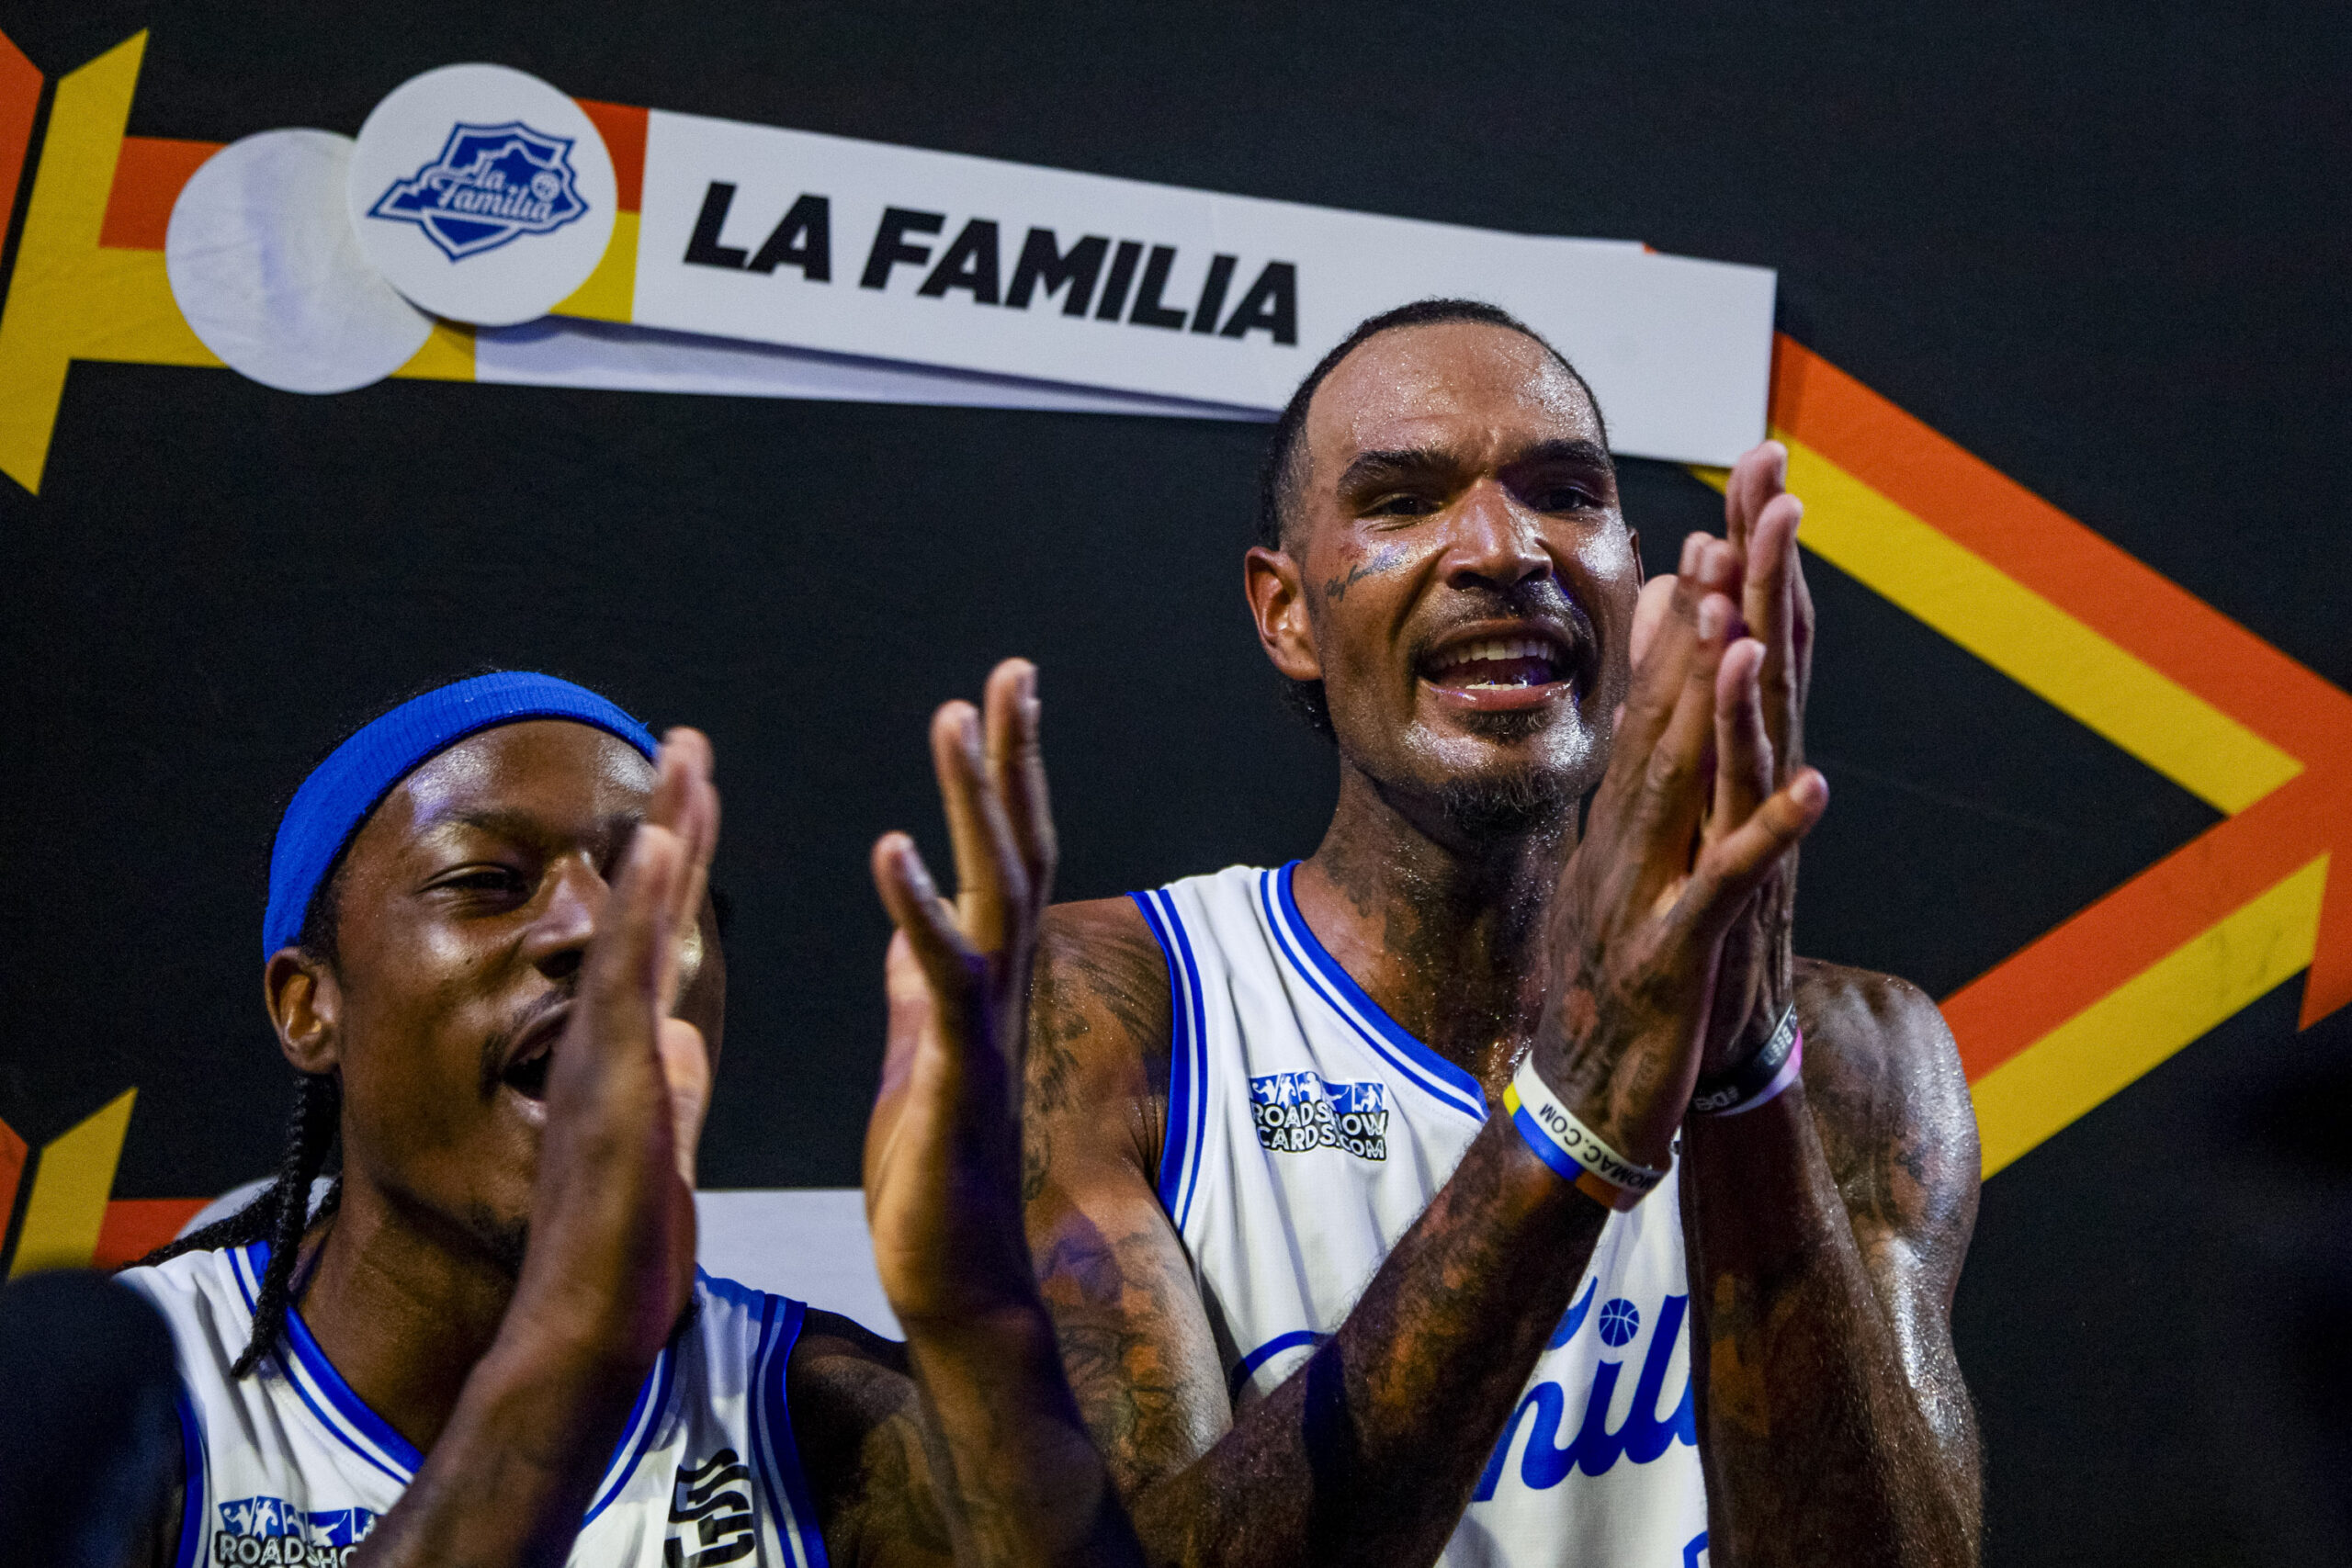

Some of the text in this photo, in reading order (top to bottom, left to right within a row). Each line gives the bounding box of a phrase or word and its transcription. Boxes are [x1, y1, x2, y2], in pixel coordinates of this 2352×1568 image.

[683, 181, 1297, 347] LA FAMILIA
[1257, 1122, 1385, 1160] CARDS.COM
